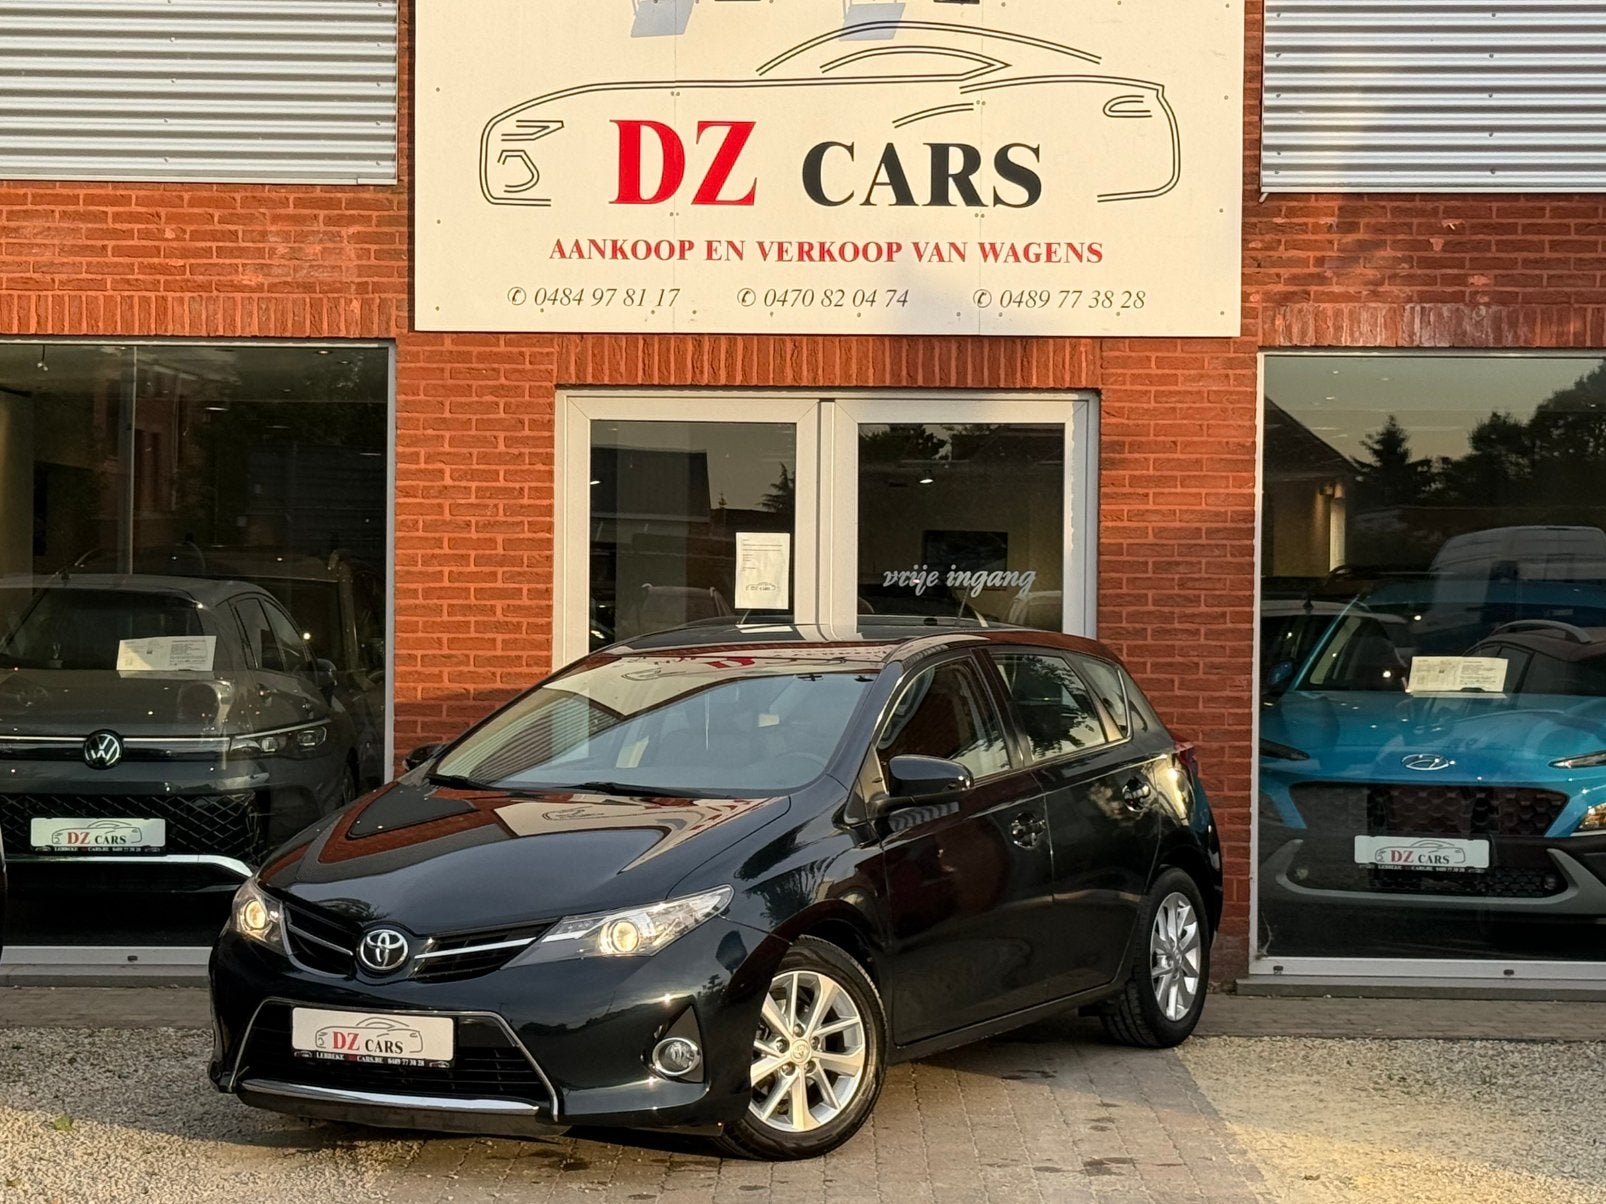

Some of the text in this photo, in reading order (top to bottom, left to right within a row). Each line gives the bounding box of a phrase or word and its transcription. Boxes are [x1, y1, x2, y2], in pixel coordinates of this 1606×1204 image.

[609, 120, 1041, 208] DZ CARS
[549, 238, 1103, 264] AANKOOP EN VERKOOP VAN WAGENS
[534, 287, 681, 307] 0484 97 81 17
[763, 288, 909, 308] 0470 82 04 74
[999, 289, 1146, 309] 0489 77 38 28
[882, 563, 1037, 598] vrije ingang
[67, 832, 127, 845] DZ CARS
[1390, 850, 1450, 865] DZ CARS
[332, 1031, 403, 1054] DZ CARS
